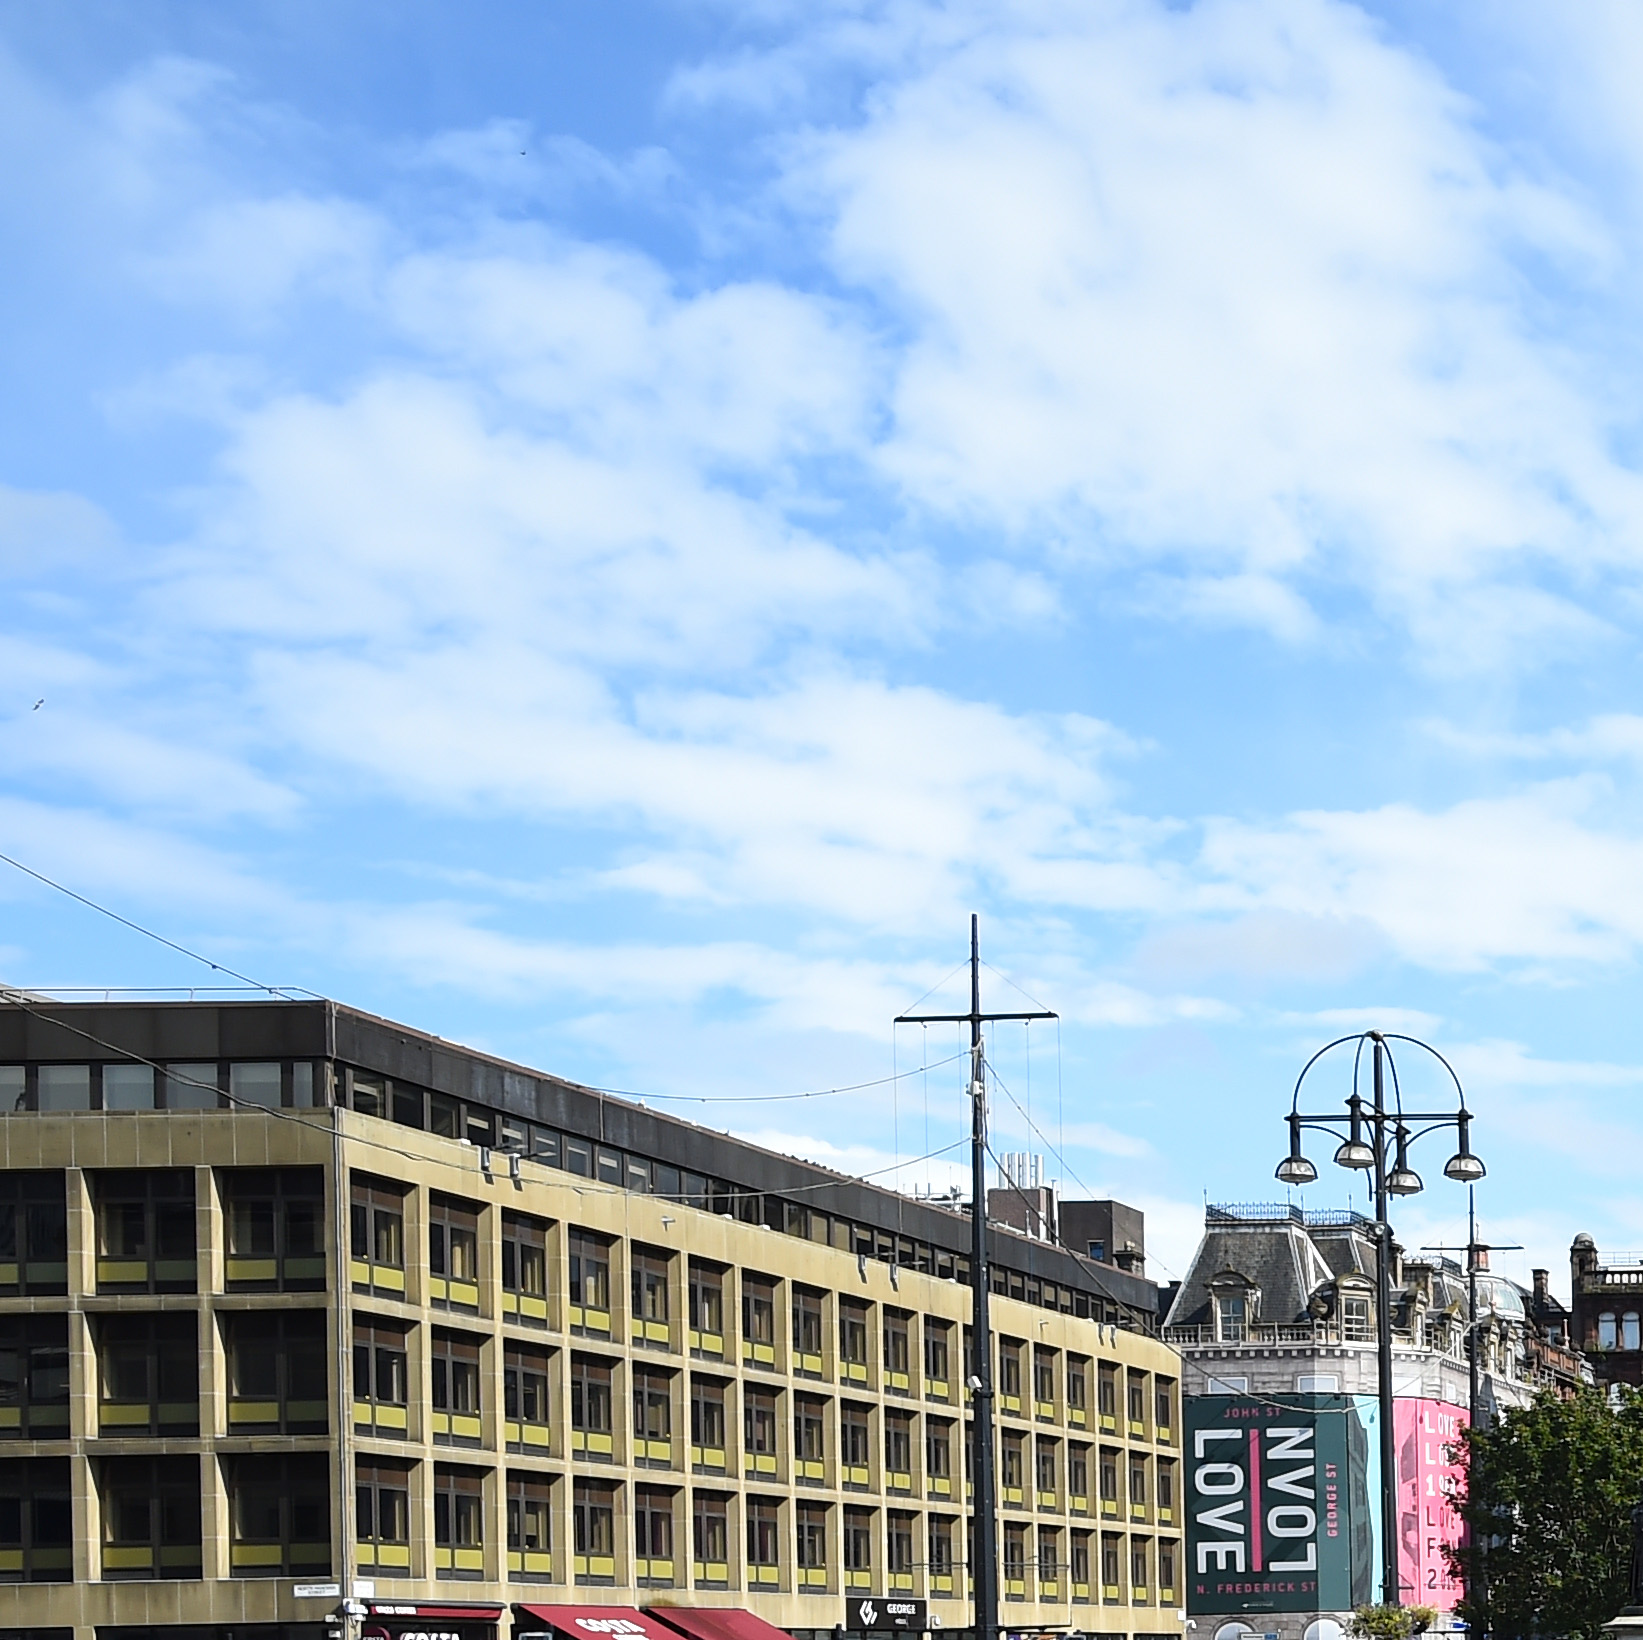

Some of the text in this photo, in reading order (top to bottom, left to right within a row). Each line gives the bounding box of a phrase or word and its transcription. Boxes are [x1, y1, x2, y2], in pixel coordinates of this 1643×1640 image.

[1223, 1407, 1282, 1418] JOHN ST
[1424, 1410, 1455, 1438] LOVE
[1194, 1428, 1246, 1574] LOVE
[1325, 1463, 1339, 1537] GEORGE ST
[1196, 1581, 1317, 1594] N. FREDERICK ST
[887, 1603, 916, 1614] GEORGE
